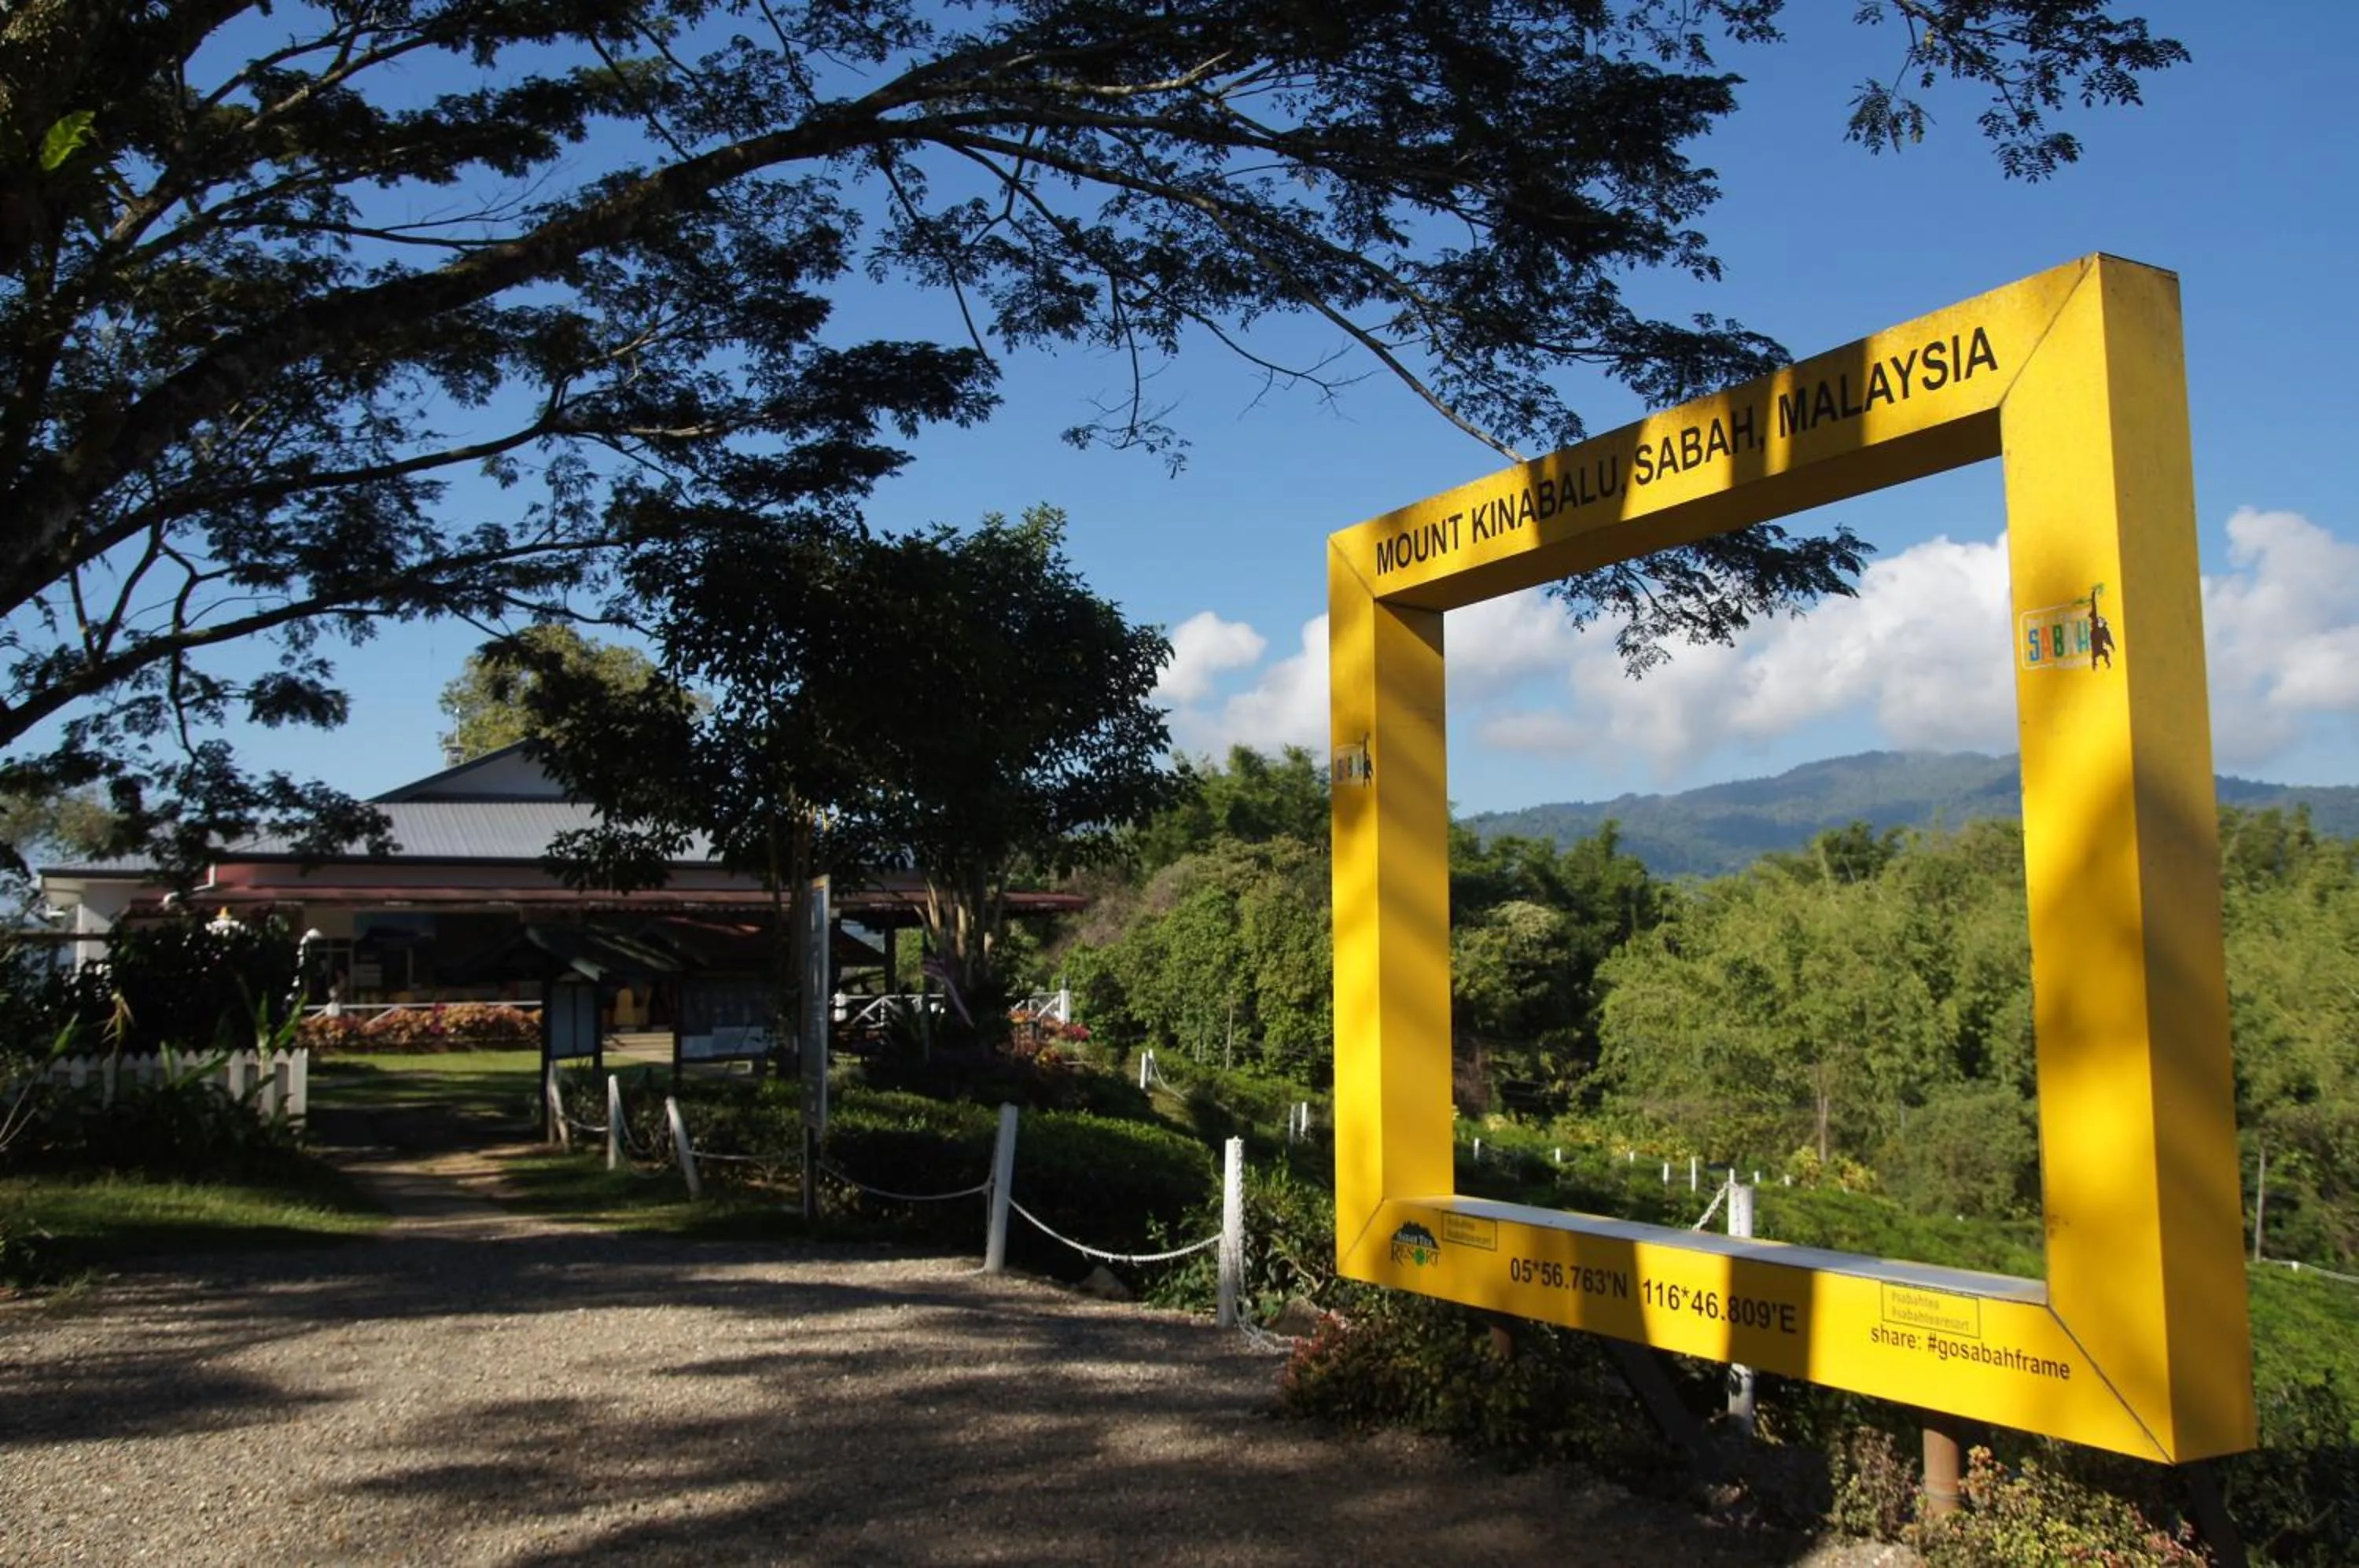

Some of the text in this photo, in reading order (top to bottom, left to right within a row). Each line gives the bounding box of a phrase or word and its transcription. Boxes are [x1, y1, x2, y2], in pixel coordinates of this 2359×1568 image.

[1377, 326, 1998, 576] MOUNT KINABALU, SABAH, MALAYSIA
[1871, 1324, 2070, 1380] share: #gosabahframe
